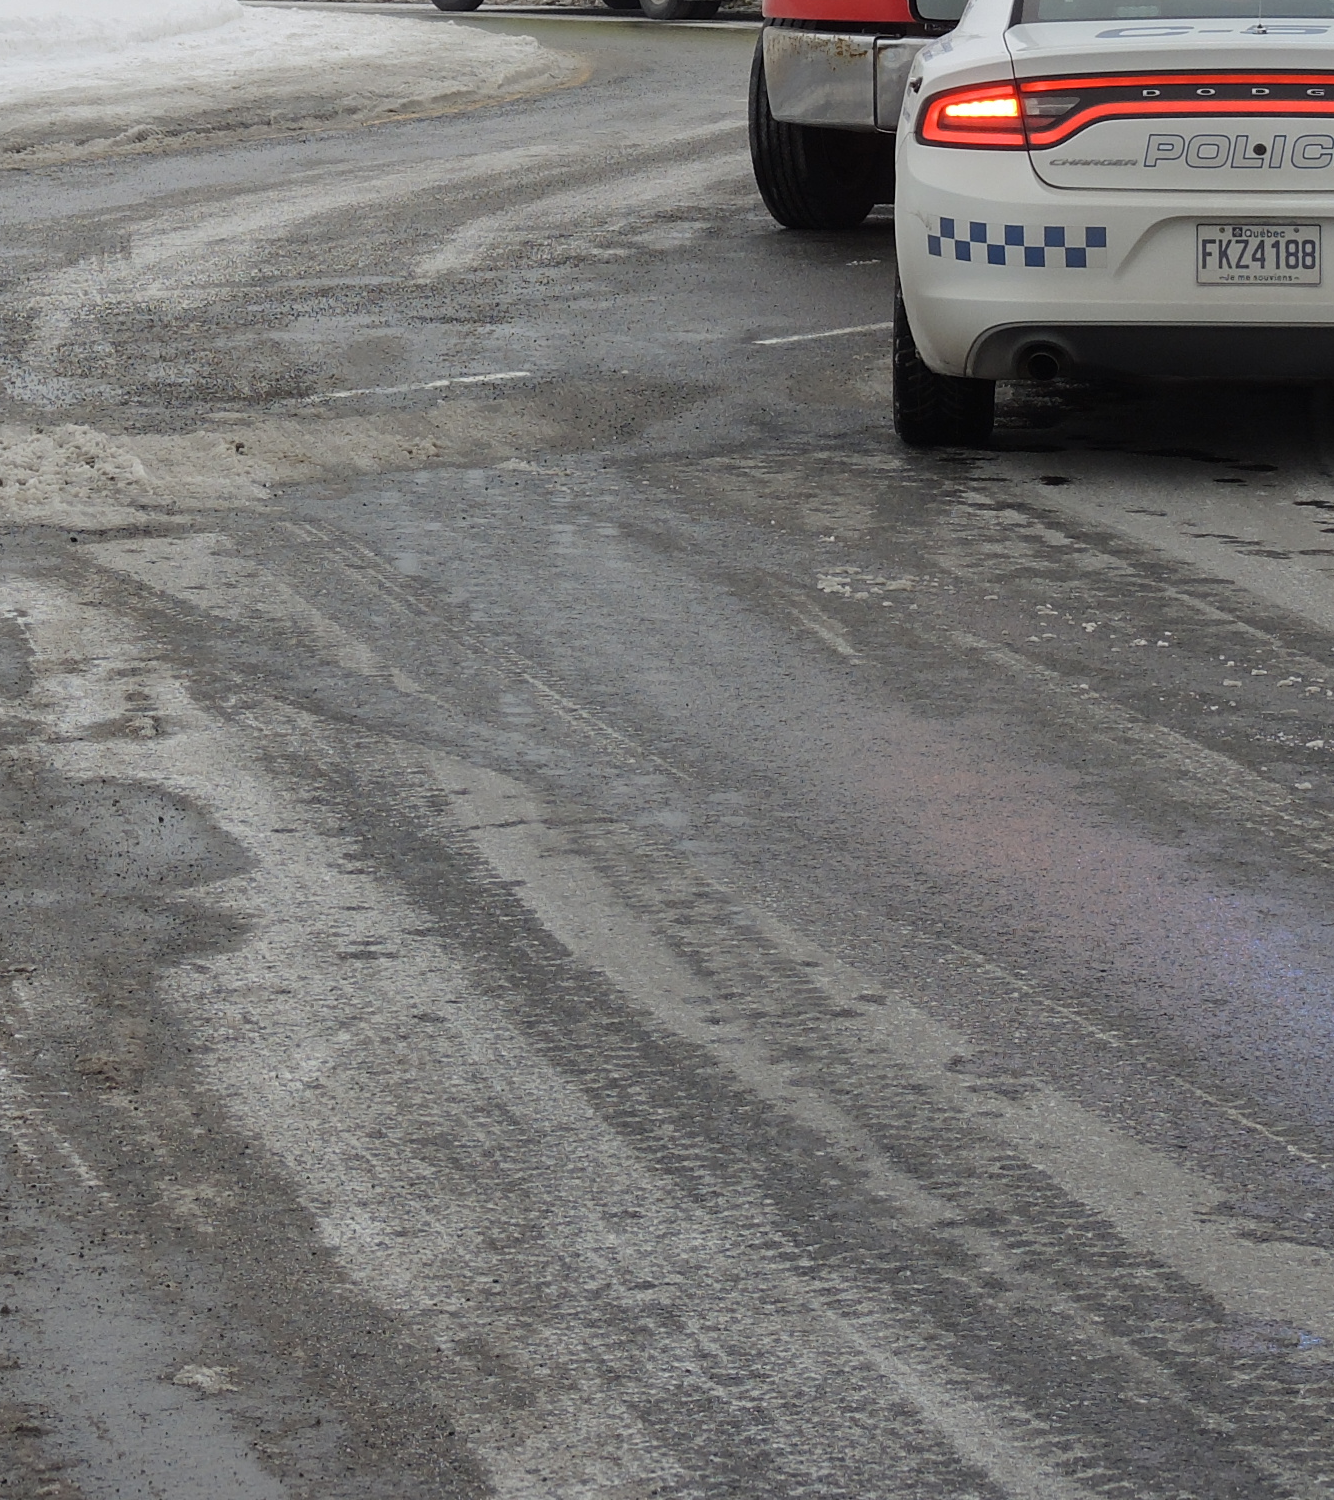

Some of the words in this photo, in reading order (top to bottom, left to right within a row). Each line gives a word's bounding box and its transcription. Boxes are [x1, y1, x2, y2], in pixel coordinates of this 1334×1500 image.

[1049, 158, 1138, 167] CHARGER
[1244, 227, 1286, 238] Québec
[1201, 238, 1316, 270] FKZ4188
[1253, 273, 1293, 281] souviens
